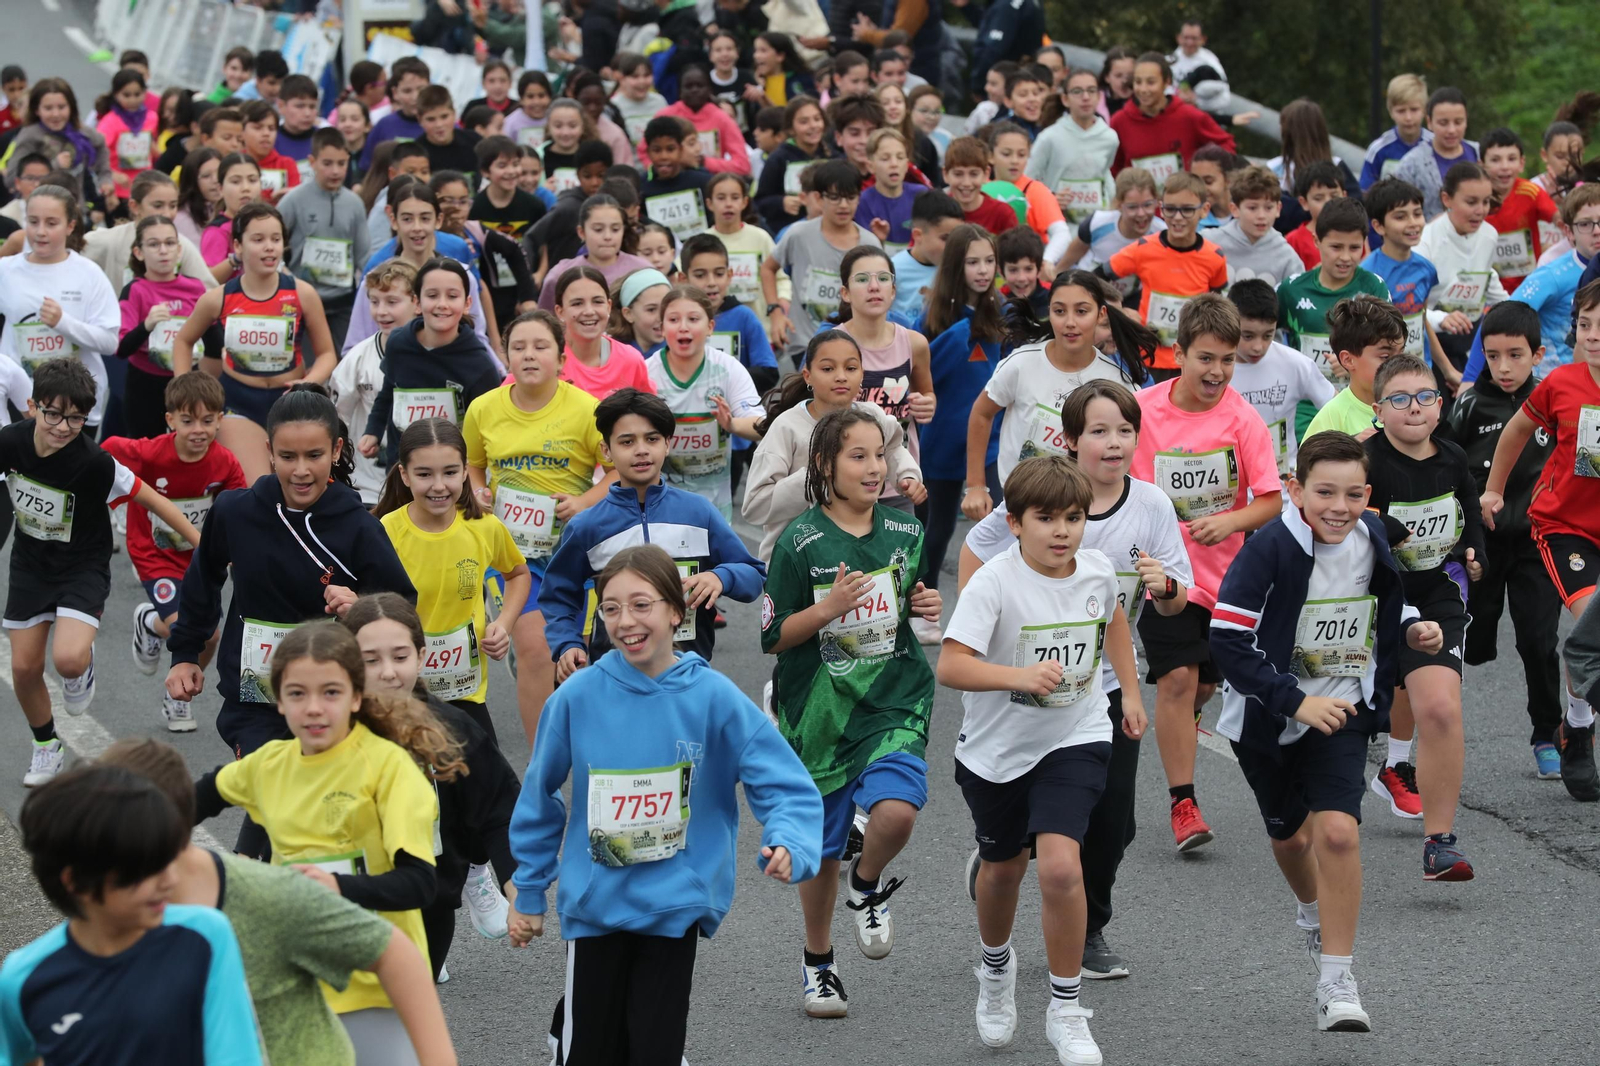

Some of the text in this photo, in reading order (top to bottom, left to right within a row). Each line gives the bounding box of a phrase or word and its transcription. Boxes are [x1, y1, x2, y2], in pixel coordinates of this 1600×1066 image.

[27, 335, 64, 352] 7509
[238, 330, 278, 346] 8050
[407, 404, 448, 423] 7774
[1478, 422, 1502, 434] Zeus
[670, 434, 712, 450] 7758
[1171, 468, 1220, 490] 8074
[16, 488, 54, 517] 7752
[504, 503, 545, 527] 7970
[884, 518, 920, 537] POVARELO
[1406, 514, 1448, 538] 7677
[1334, 606, 1348, 614] JAIME
[1053, 631, 1069, 640] ROQUE
[1314, 618, 1358, 641] 7016
[1035, 643, 1086, 666] 7017
[633, 779, 652, 788] EMMA
[612, 792, 673, 820] 7757
